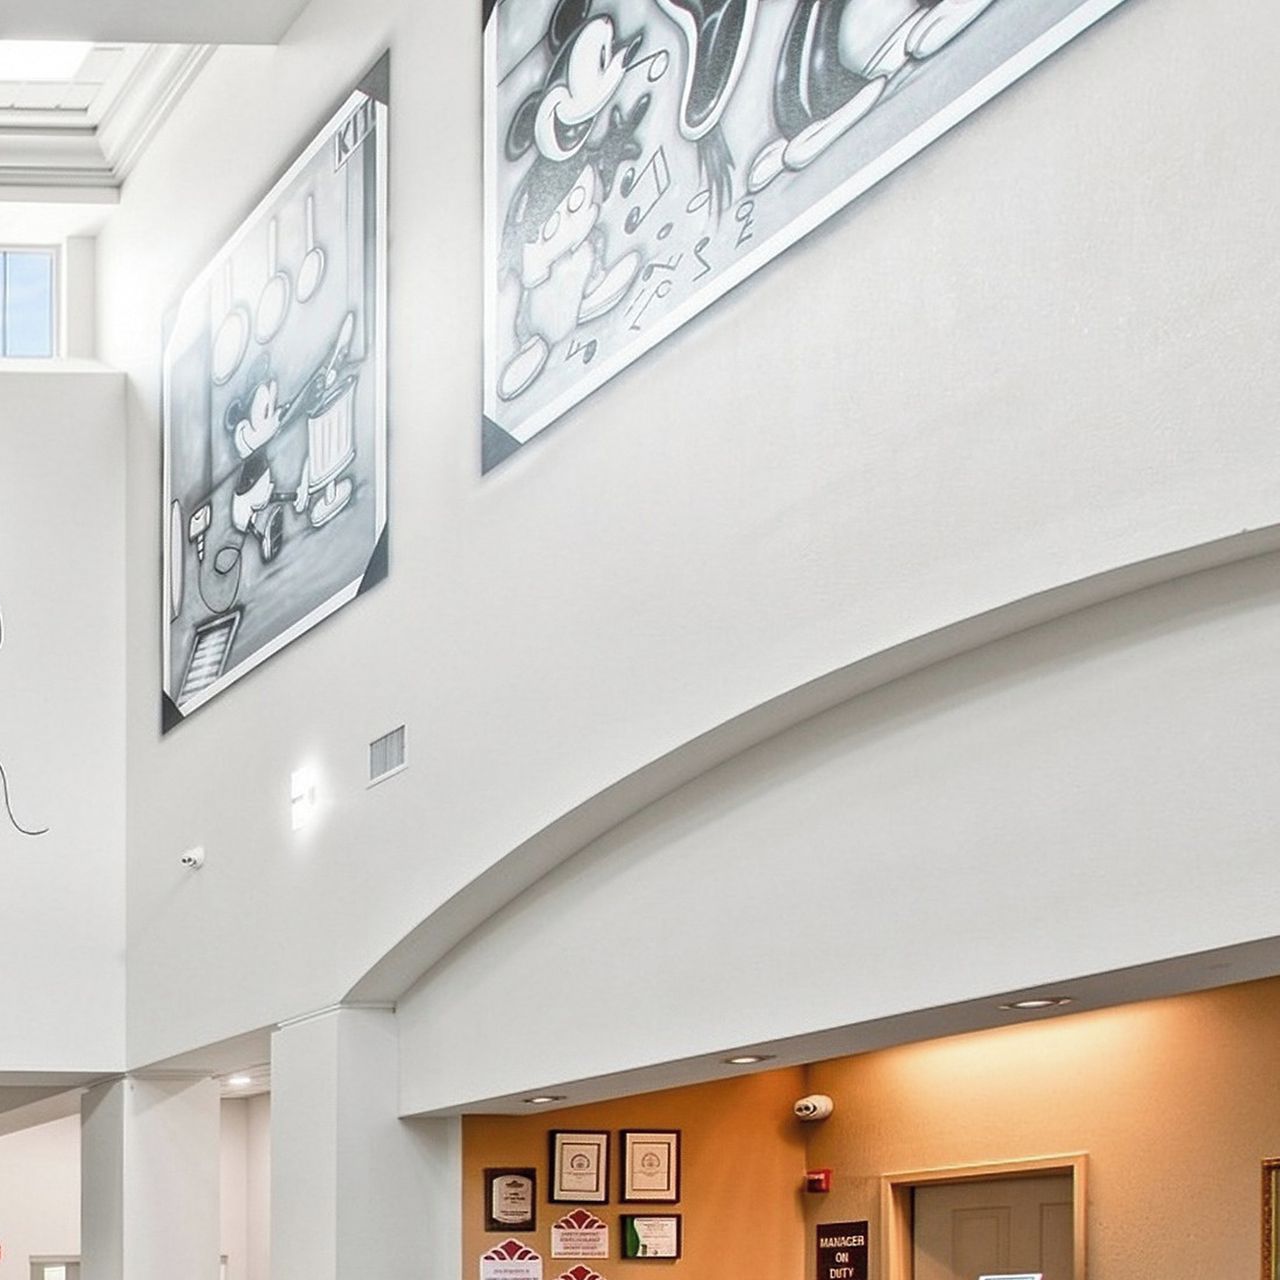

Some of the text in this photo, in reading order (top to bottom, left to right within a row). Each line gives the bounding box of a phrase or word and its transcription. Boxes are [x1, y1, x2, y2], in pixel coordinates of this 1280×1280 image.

[819, 1235, 865, 1248] MANAGER
[835, 1252, 849, 1263] ON
[829, 1268, 854, 1279] DUTY
